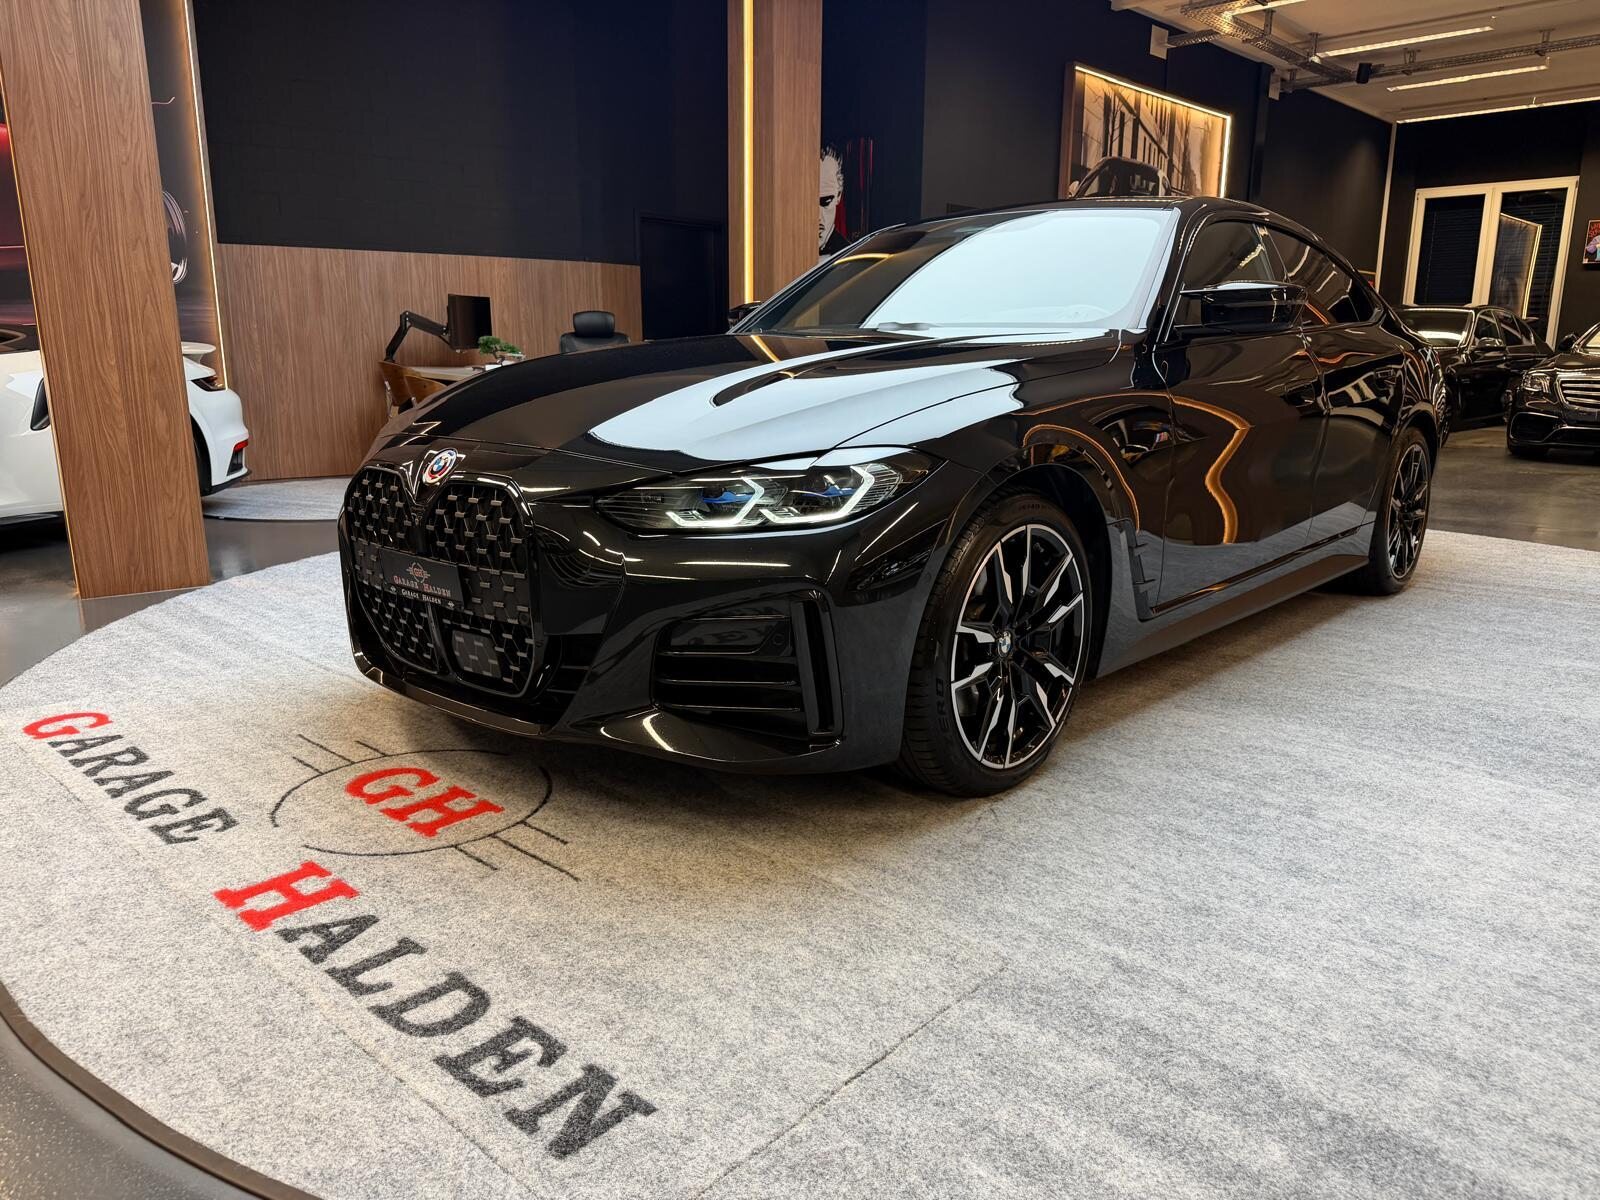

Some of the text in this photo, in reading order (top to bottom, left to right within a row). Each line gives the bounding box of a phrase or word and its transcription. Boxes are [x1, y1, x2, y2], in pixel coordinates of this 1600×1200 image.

[344, 766, 505, 838] GH
[22, 712, 658, 1159] GARAGE HALDEN
